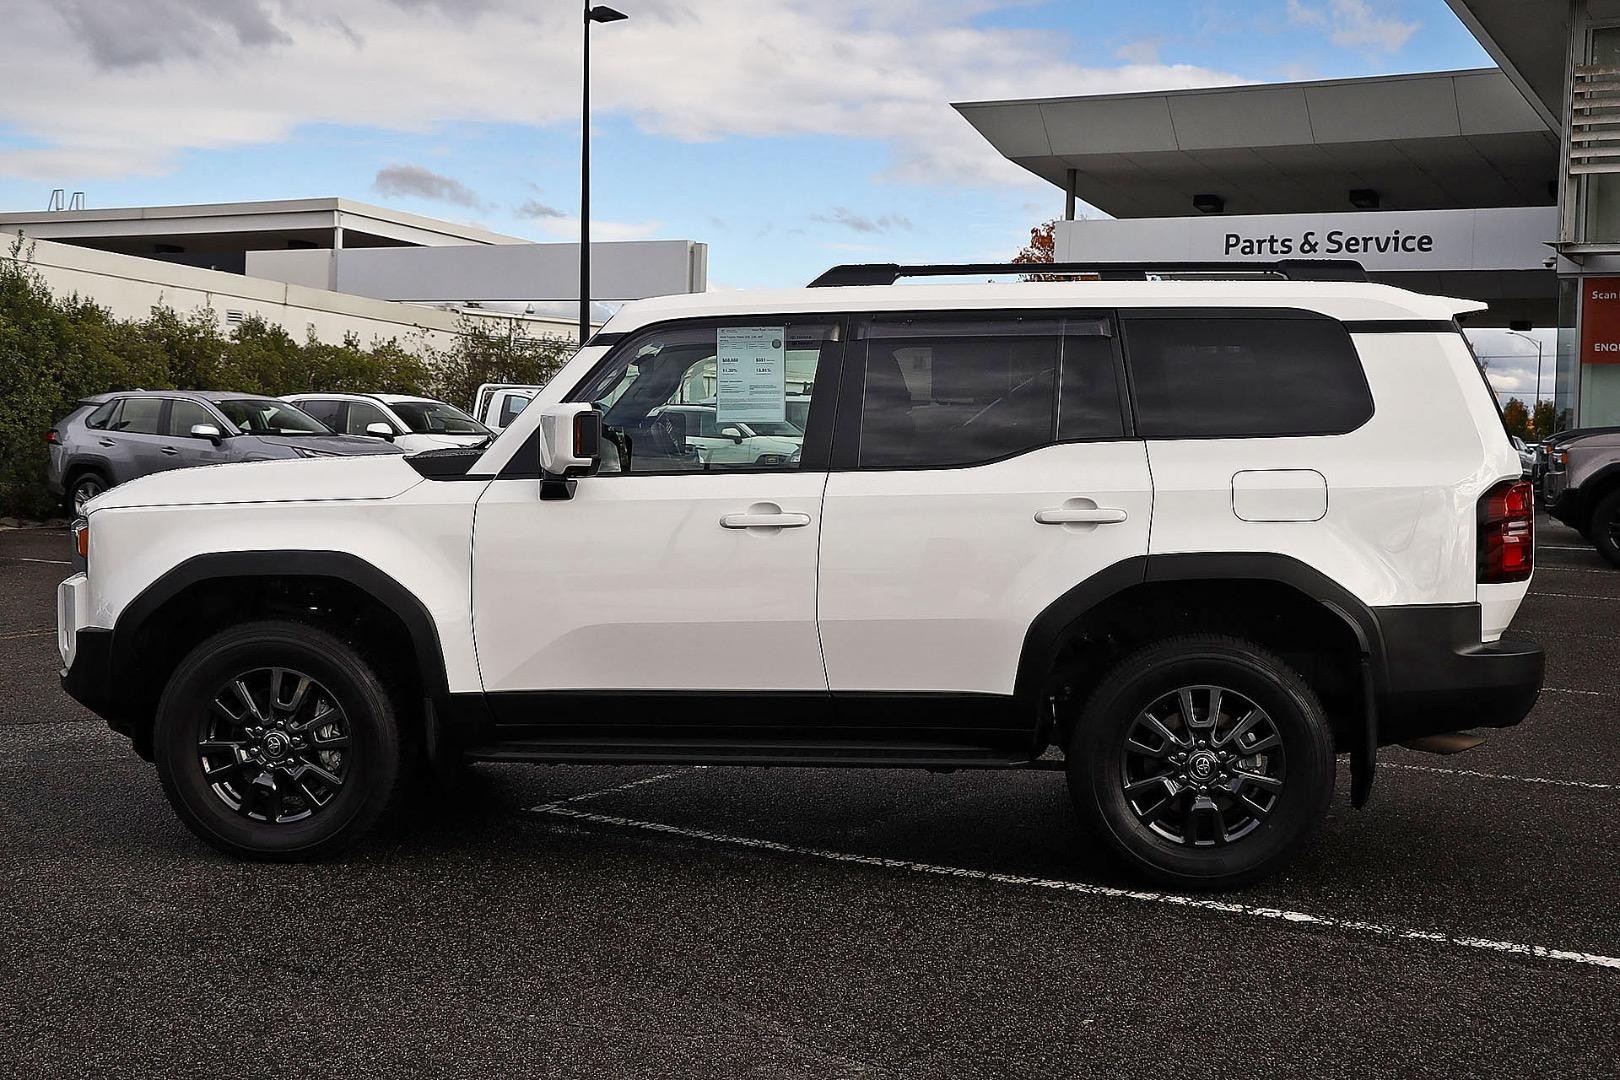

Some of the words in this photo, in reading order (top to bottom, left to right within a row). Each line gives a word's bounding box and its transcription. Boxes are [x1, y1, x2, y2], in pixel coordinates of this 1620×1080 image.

[1224, 233, 1293, 256] Parts
[1298, 231, 1320, 254] &
[1325, 229, 1433, 254] Service
[1592, 290, 1617, 299] Scan
